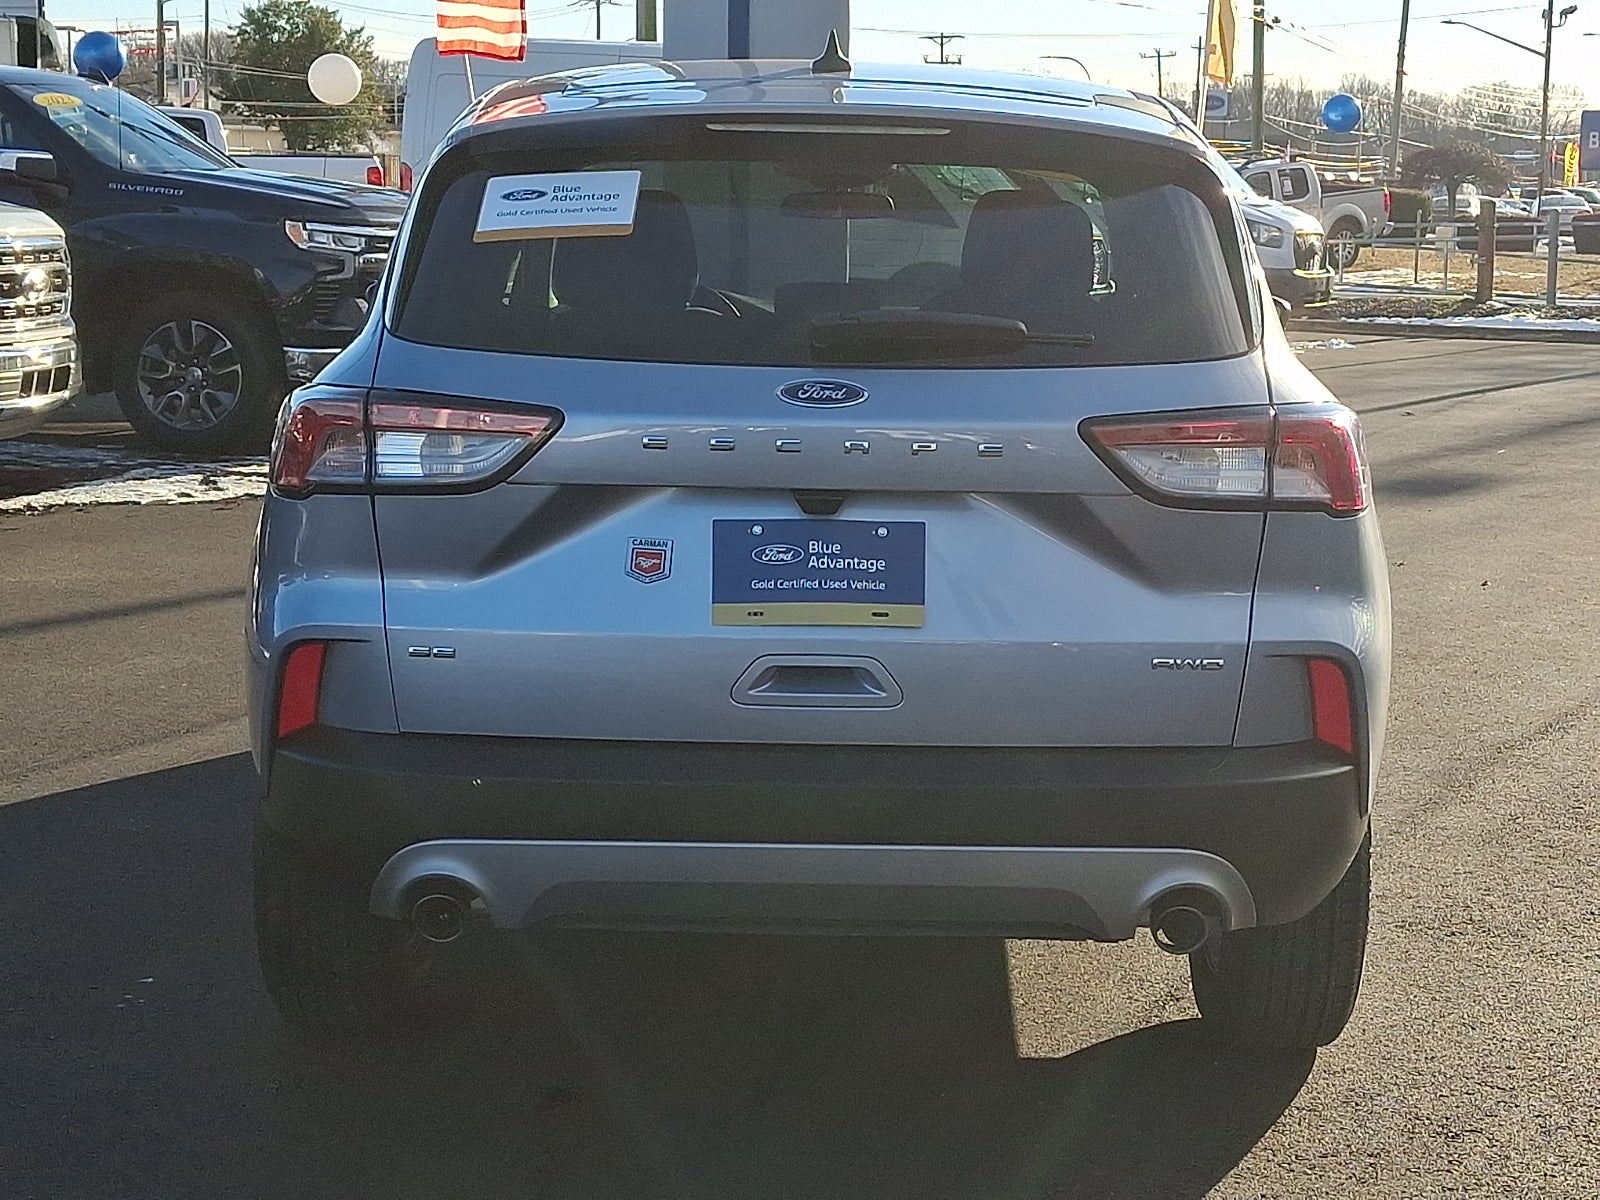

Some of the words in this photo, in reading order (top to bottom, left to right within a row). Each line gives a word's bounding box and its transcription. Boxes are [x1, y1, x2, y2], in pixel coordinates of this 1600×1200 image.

[108, 182, 184, 196] SILVERADO
[508, 190, 541, 200] Ford
[552, 185, 582, 194] Blue
[550, 193, 621, 202] Advantage
[496, 210, 518, 218] Gold
[519, 208, 558, 217] Certified
[560, 206, 584, 214] Used
[586, 205, 618, 213] Vehicle
[797, 382, 848, 401] Ford
[641, 434, 1004, 458] ESCAPE
[632, 538, 669, 548] CARMAN
[808, 541, 842, 555] Blue
[761, 546, 795, 562] Ford
[807, 554, 887, 573] Advantage
[751, 579, 775, 590] Gold
[777, 578, 819, 590] Certified
[821, 579, 848, 590] Used
[849, 580, 886, 591] Vehicle
[408, 645, 456, 658] SE
[1151, 657, 1225, 671] AWD
